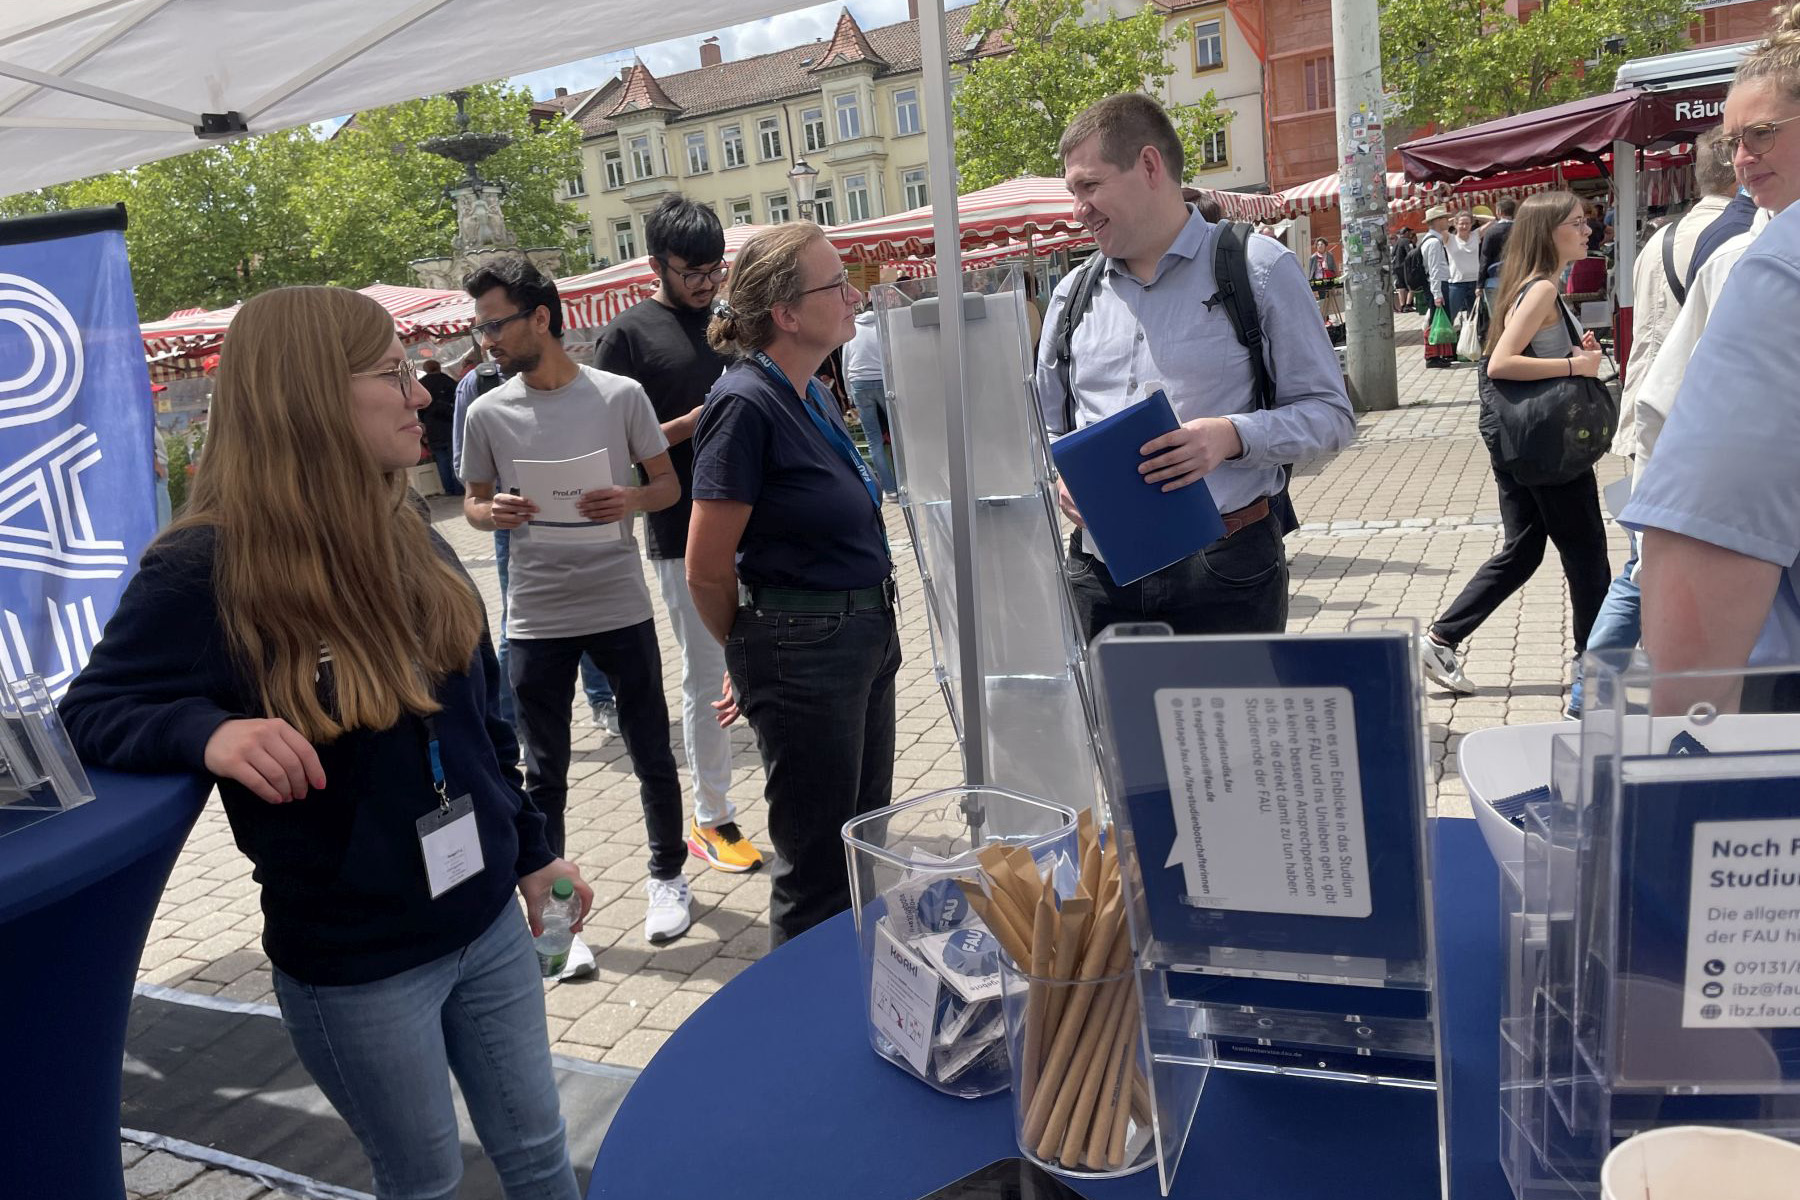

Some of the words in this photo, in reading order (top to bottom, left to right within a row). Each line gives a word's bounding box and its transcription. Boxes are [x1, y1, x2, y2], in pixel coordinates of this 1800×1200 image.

[755, 352, 772, 368] FAU
[856, 465, 872, 483] FAU
[1264, 698, 1278, 713] als
[1284, 698, 1294, 711] es
[1303, 698, 1314, 711] an
[1324, 698, 1336, 730] Wenn
[1245, 698, 1265, 766] Studierende
[1267, 717, 1279, 736] die,
[1286, 714, 1299, 744] keine
[1305, 715, 1319, 734] der
[1270, 741, 1283, 757] die
[1308, 738, 1322, 760] FAU
[1327, 734, 1337, 746] es
[1328, 750, 1339, 767] um
[1255, 769, 1268, 787] der
[1272, 761, 1287, 792] direkt
[1290, 748, 1304, 796] besseren
[1310, 764, 1326, 785] und
[1258, 791, 1272, 814] FAU.
[1314, 788, 1326, 803] ins
[1330, 771, 1347, 819] Einblicke
[1276, 795, 1291, 825] damit
[1281, 828, 1291, 840] zu
[1315, 807, 1330, 853] Unileben
[1336, 822, 1348, 832] in
[1283, 843, 1293, 859] tun
[1296, 800, 1316, 896] Ansprechpersonen
[1337, 834, 1350, 852] das
[1712, 839, 1780, 858] Noch
[1318, 856, 1335, 881] geht,
[1339, 856, 1354, 897] Studium
[1285, 862, 1299, 896] haben:
[1710, 869, 1800, 888] Studiu
[1321, 884, 1338, 904] gibt
[938, 898, 959, 933] FAU
[1707, 906, 1738, 922] Die
[961, 929, 984, 953] FAU
[1705, 930, 1736, 944] der
[1742, 929, 1779, 943] FAU
[890, 945, 919, 978] KORKI
